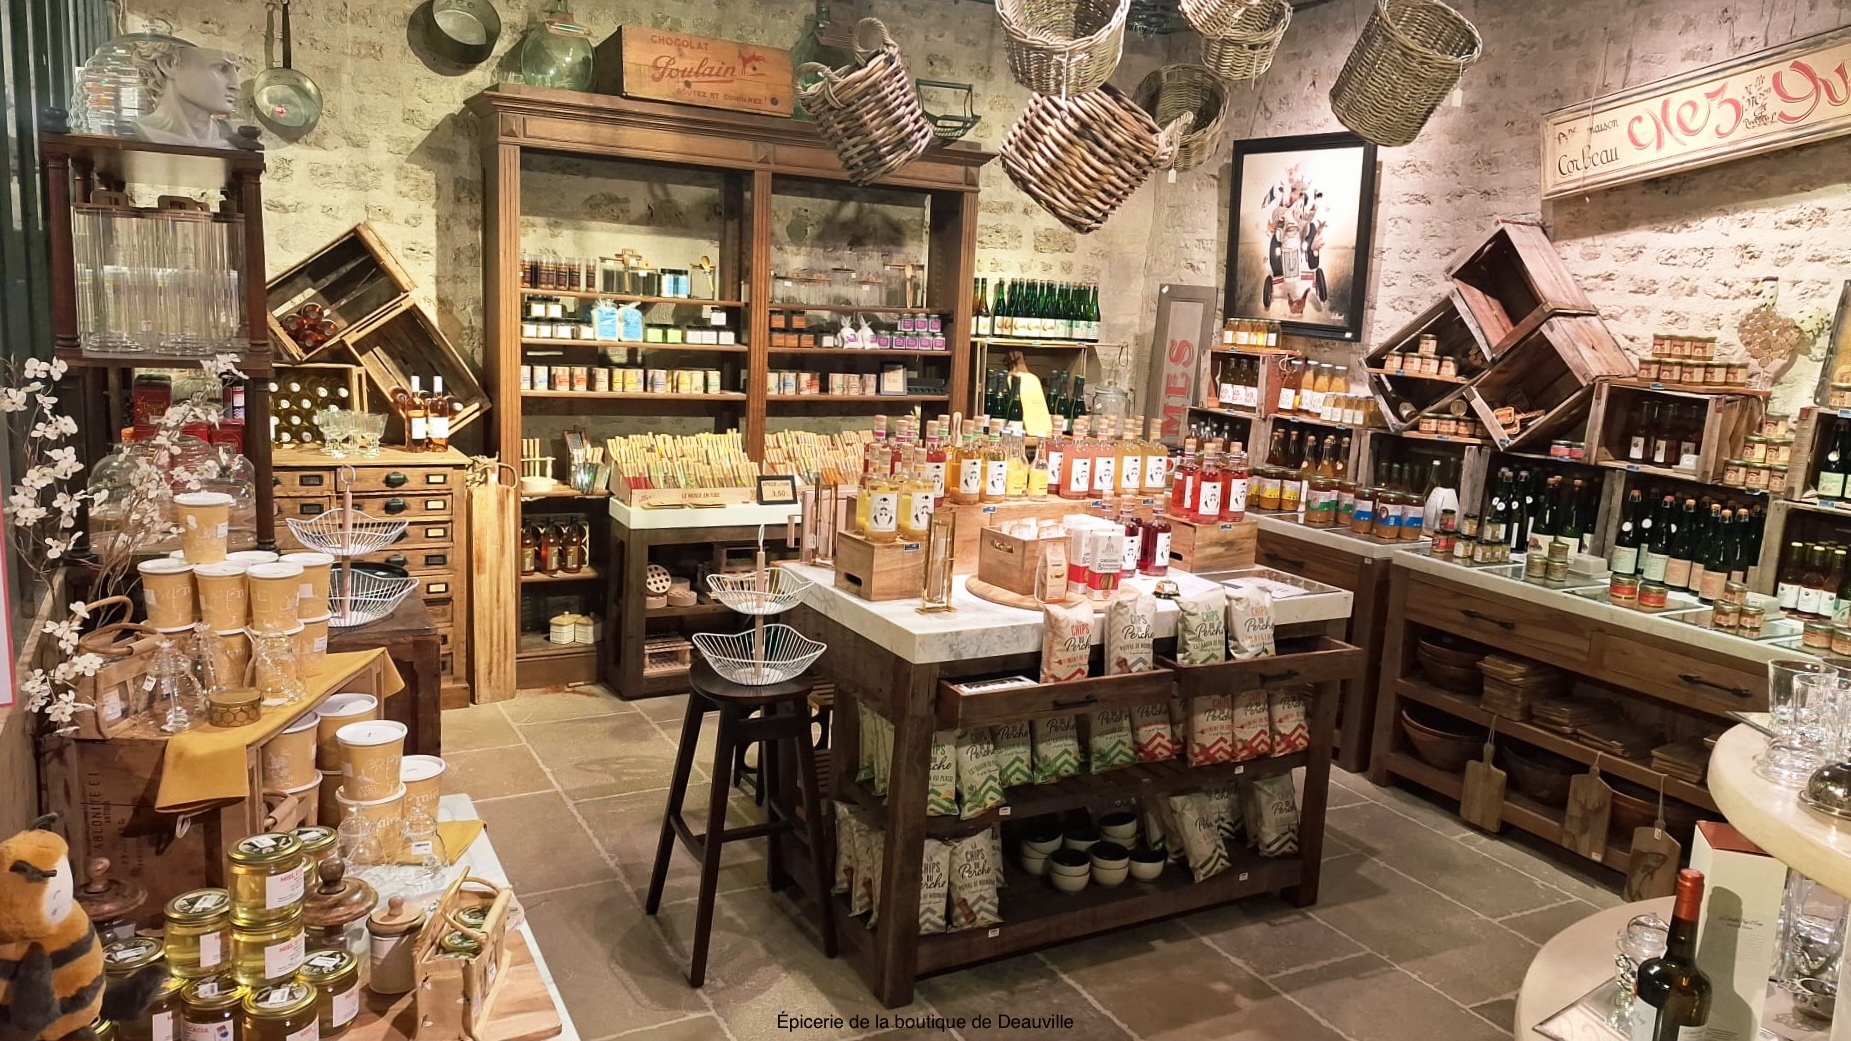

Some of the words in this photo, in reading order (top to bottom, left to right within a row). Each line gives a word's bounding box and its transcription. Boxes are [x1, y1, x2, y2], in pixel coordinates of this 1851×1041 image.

[651, 35, 709, 51] CHOCOLAT
[651, 55, 737, 83] Poulain
[677, 88, 707, 99] GOUTEZ
[1558, 144, 1620, 178] Corbeau
[1071, 623, 1090, 636] CHIPS
[1121, 624, 1155, 640] Perche
[965, 848, 986, 862] CHIPS
[958, 859, 991, 880] Perche
